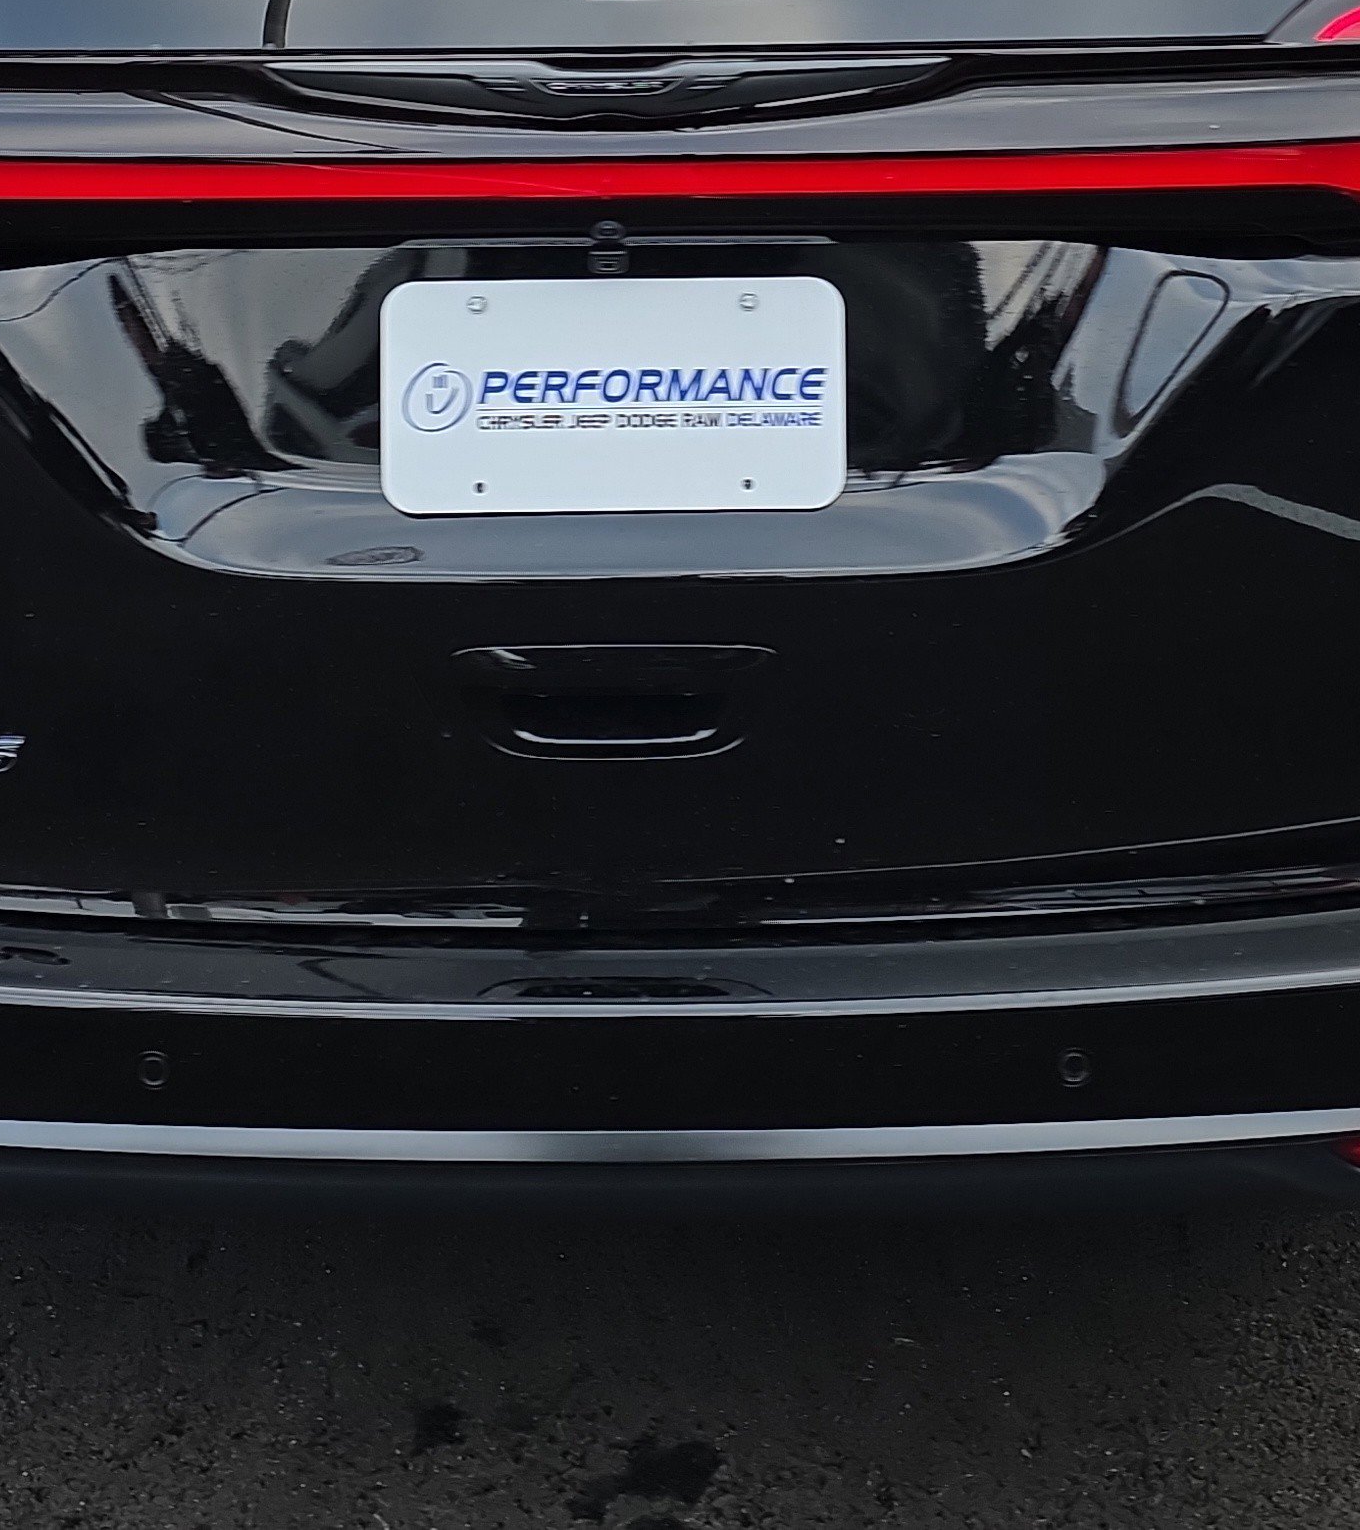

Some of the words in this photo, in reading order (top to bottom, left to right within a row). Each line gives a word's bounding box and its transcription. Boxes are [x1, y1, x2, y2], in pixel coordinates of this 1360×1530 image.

[479, 368, 828, 404] PERFORMANCE
[615, 413, 678, 428] DODGE
[726, 412, 823, 427] DELAWARE
